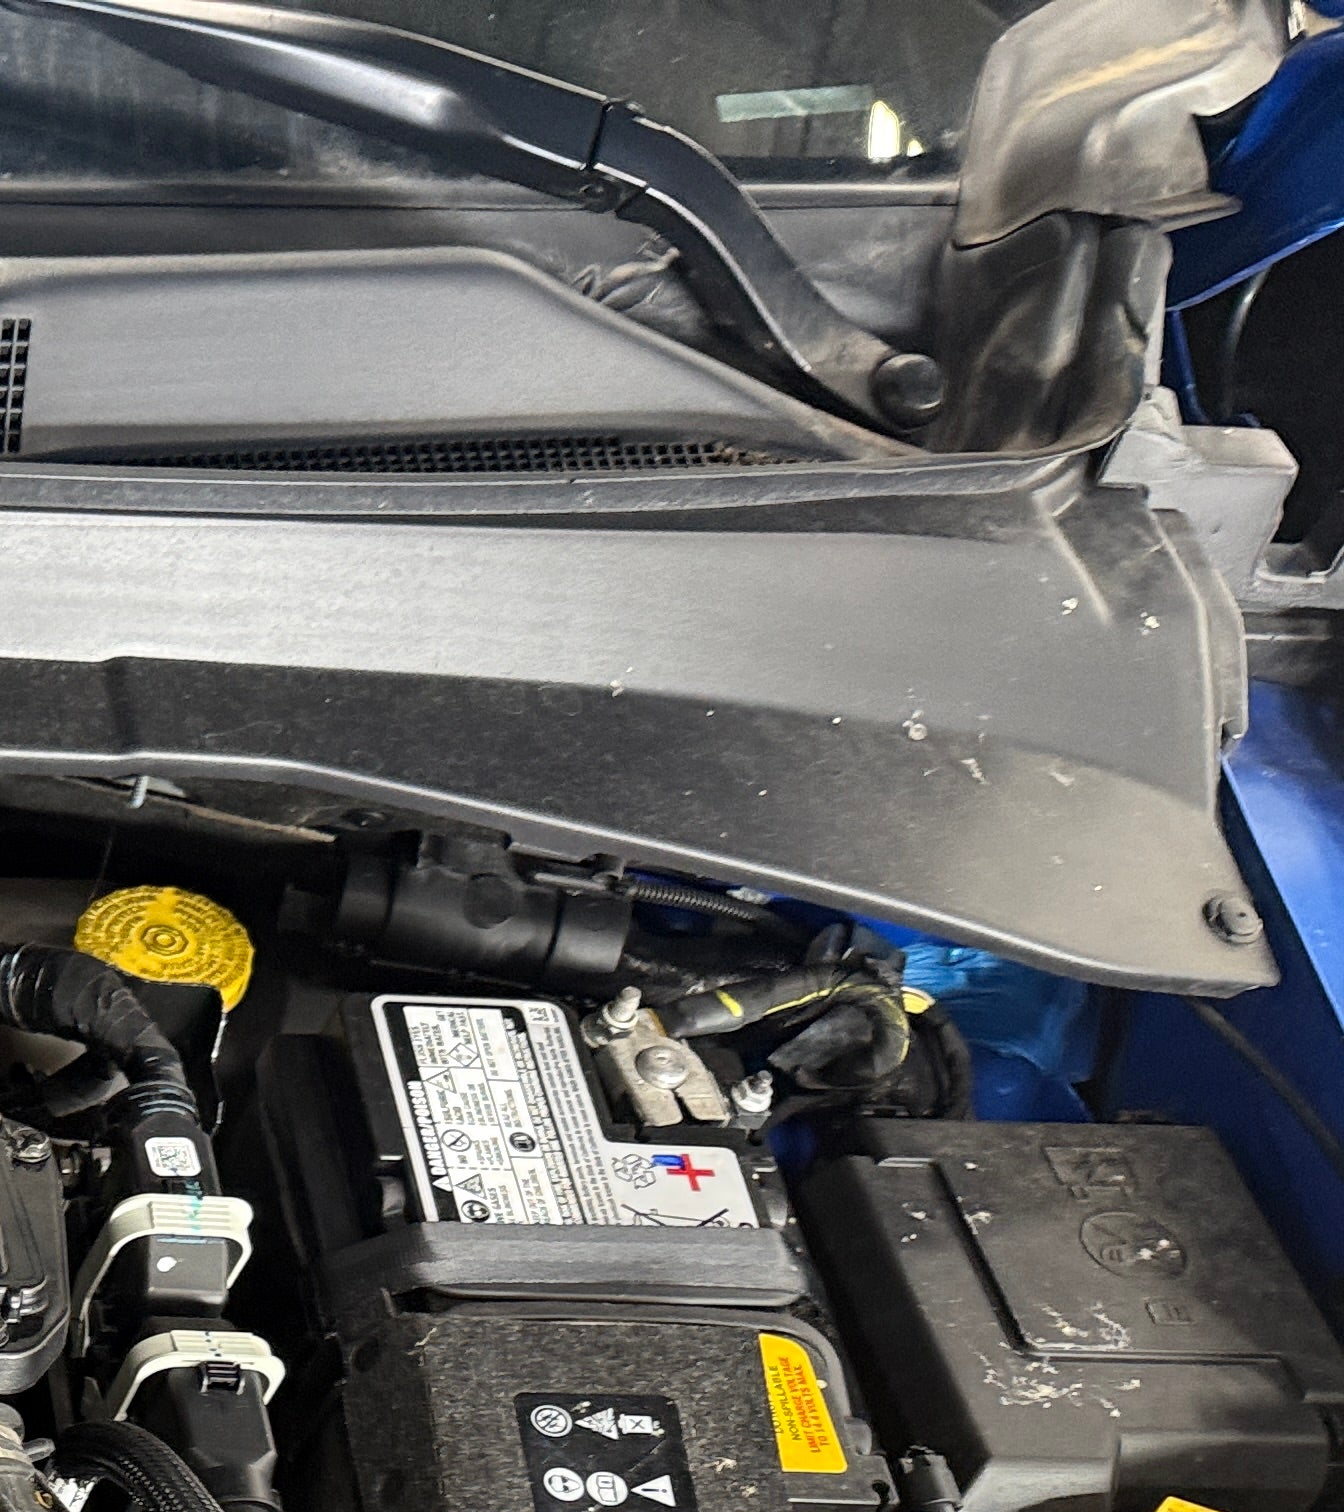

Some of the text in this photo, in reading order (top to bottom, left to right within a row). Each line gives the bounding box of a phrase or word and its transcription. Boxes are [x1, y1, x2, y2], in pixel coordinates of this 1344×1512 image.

[408, 1081, 447, 1175] DANGER/POISON
[768, 1366, 802, 1441] NON-SPILLABLE
[778, 1356, 822, 1453] LIMIT CHARGE VOLTAGE
